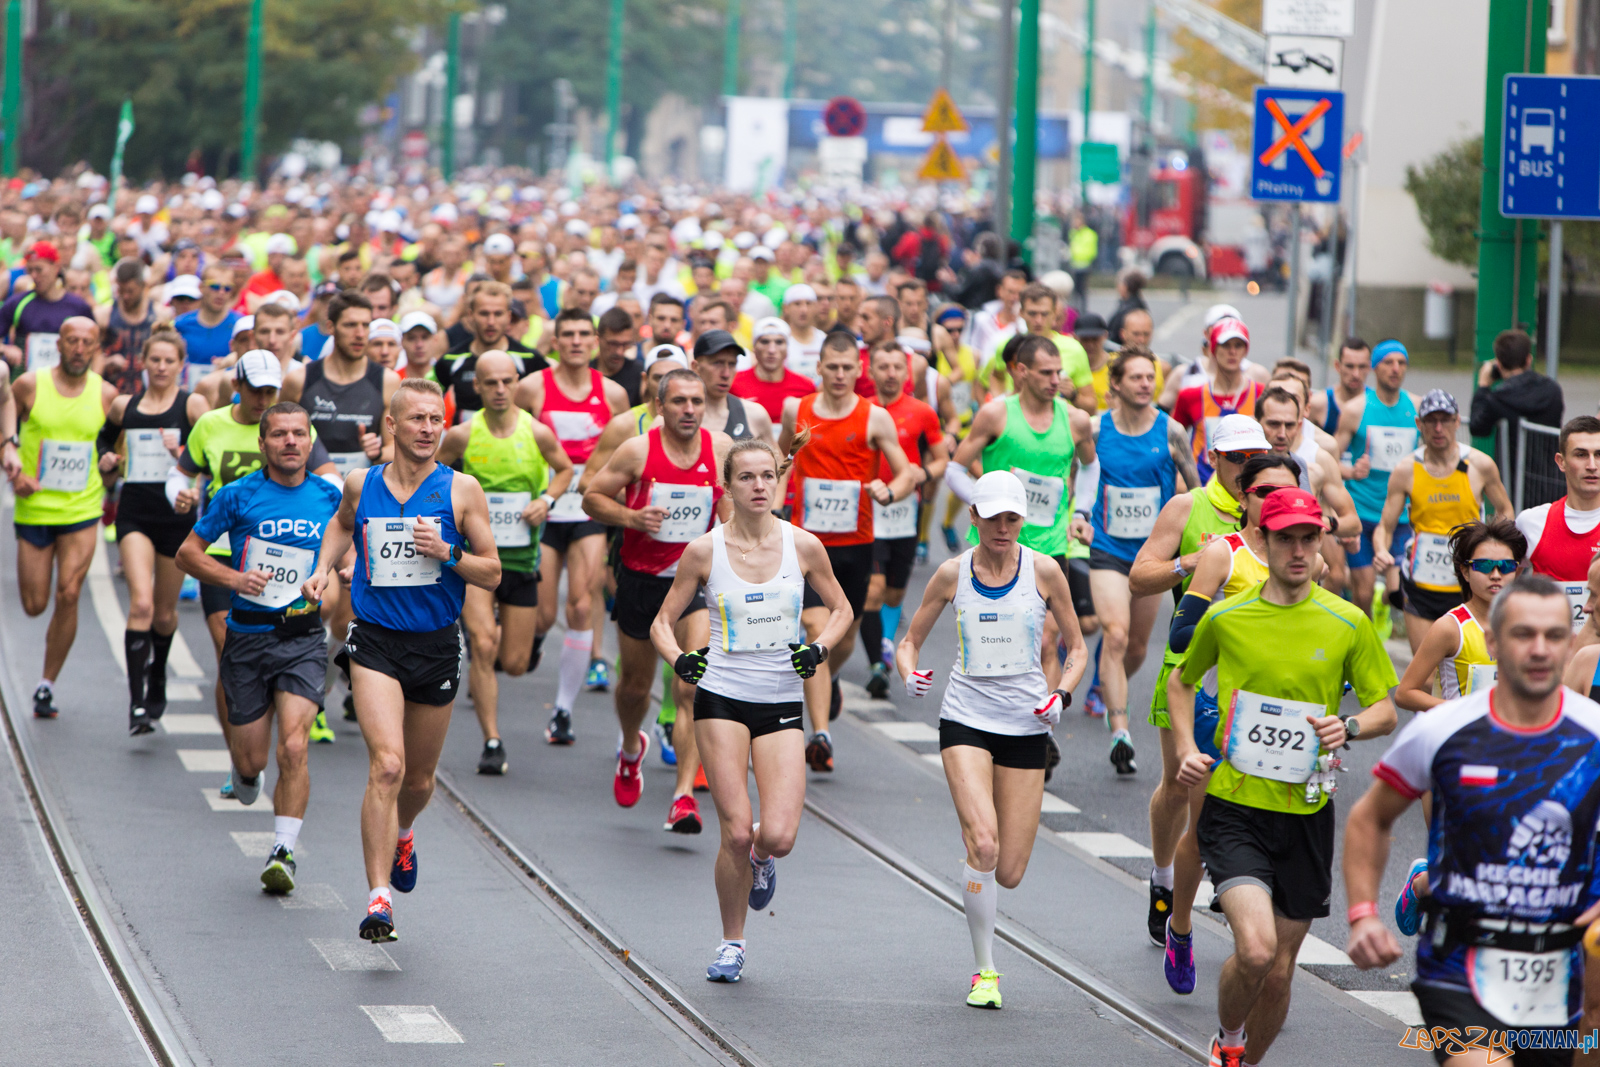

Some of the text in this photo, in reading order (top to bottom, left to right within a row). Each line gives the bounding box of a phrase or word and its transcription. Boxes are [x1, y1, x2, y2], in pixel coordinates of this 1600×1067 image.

[1519, 159, 1554, 177] BUS
[50, 456, 86, 471] 7300
[814, 498, 850, 511] 4772
[1115, 504, 1152, 518] 6350
[258, 518, 322, 540] OPEX
[380, 541, 427, 559] 675
[746, 615, 782, 625] Somava
[980, 635, 1012, 644] Stanko
[1248, 723, 1306, 751] 6392
[1265, 747, 1285, 756] Kamil
[1500, 958, 1558, 984] 1395
